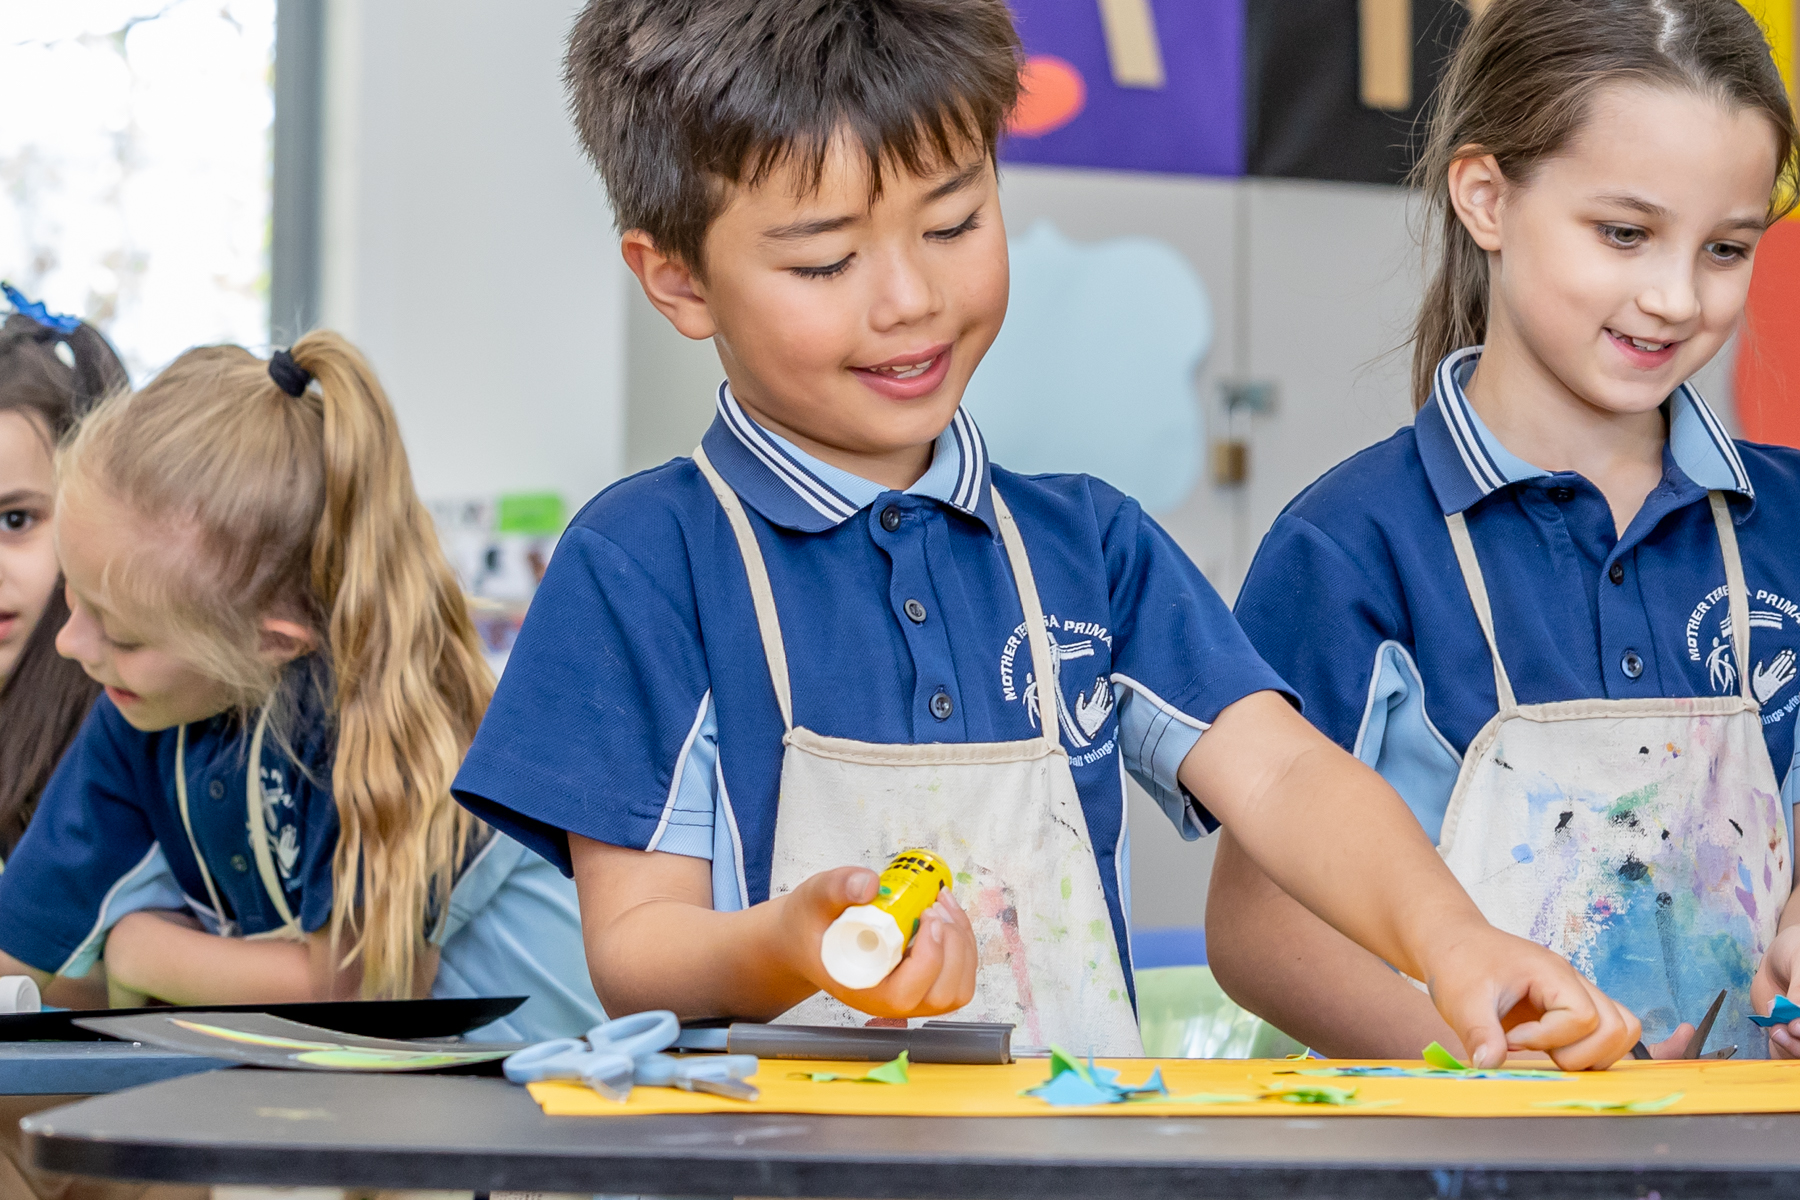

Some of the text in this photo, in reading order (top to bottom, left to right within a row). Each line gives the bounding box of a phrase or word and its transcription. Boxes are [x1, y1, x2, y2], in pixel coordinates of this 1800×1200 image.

[1001, 635, 1021, 701] MOTHER
[1064, 620, 1112, 652] PRIMA
[1687, 601, 1711, 661] MOTHER
[1083, 739, 1114, 764] things
